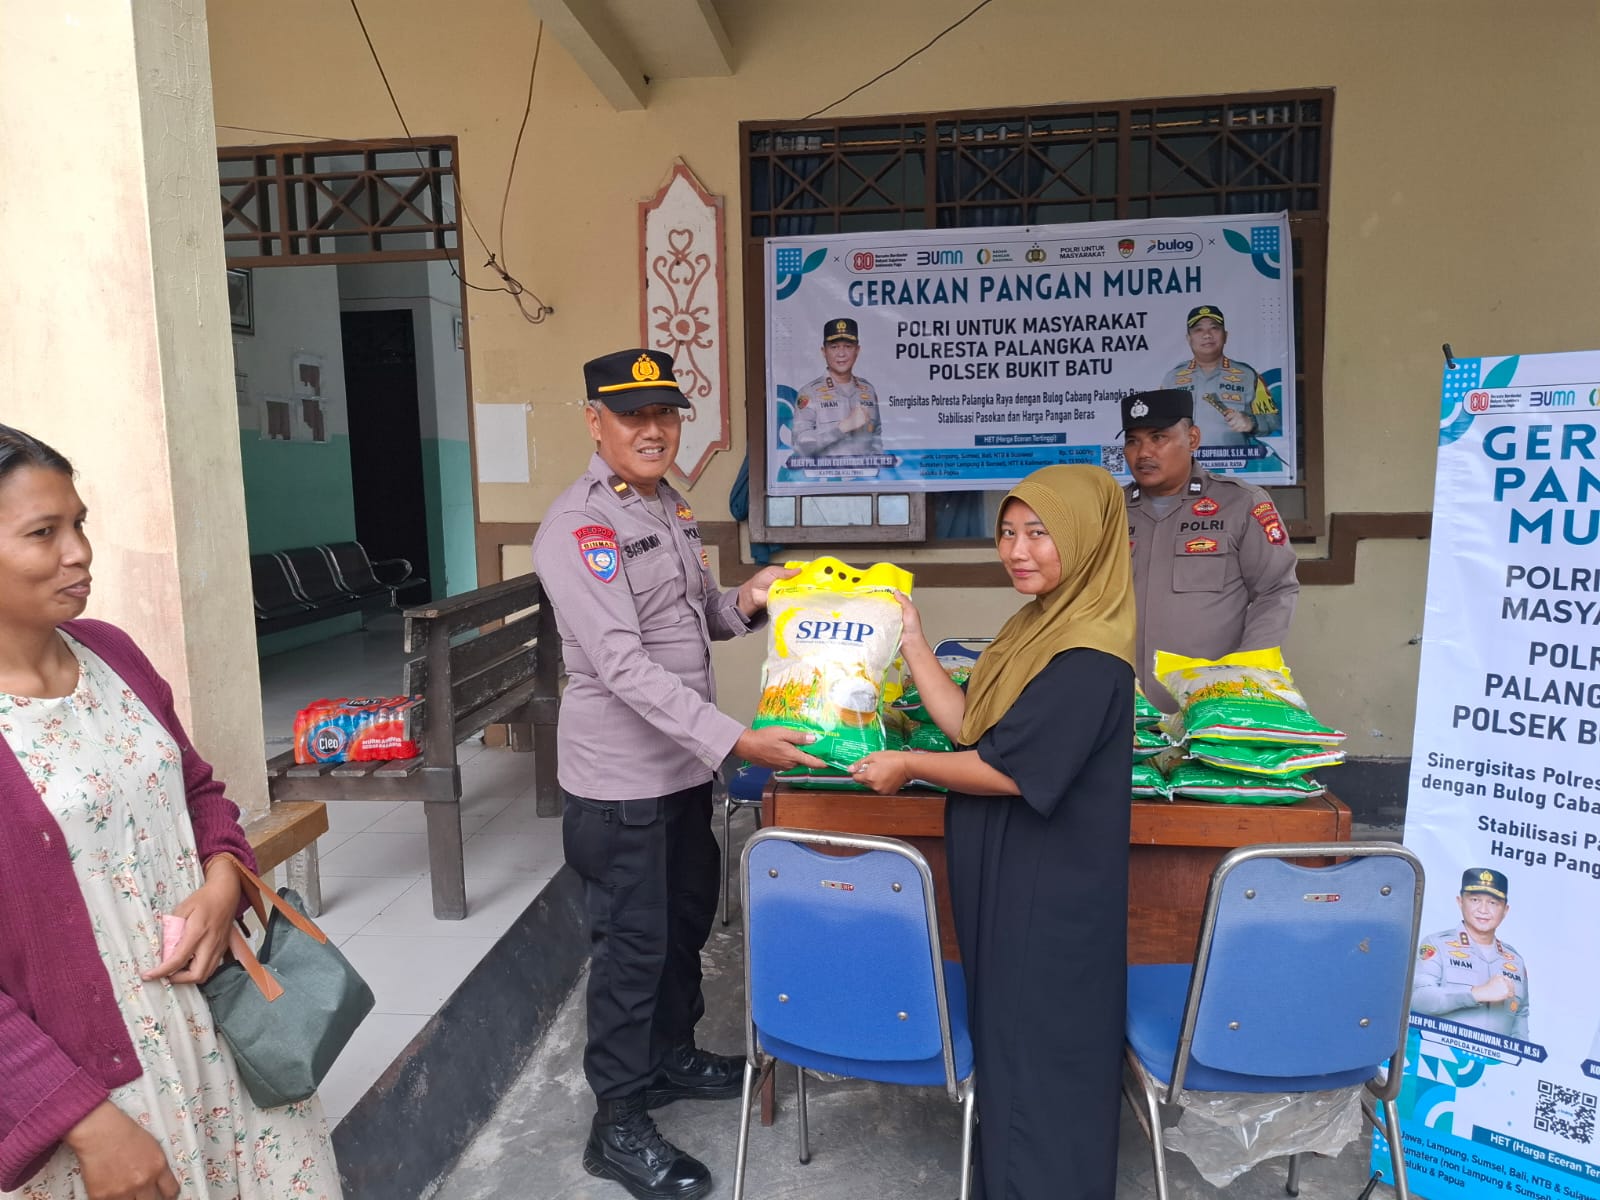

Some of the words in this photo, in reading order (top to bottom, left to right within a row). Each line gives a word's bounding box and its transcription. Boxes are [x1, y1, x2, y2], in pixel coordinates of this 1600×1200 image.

[1059, 251, 1105, 259] MASYARAKAT
[1158, 239, 1193, 252] bulog
[848, 277, 967, 306] GERAKAN
[980, 272, 1091, 303] PANGAN
[1104, 266, 1201, 297] MURAH
[898, 320, 950, 338] POLRI
[957, 318, 1016, 336] UNTUK
[1023, 312, 1148, 334] MASYARAKAT
[896, 340, 987, 360] POLRESTA
[995, 337, 1095, 357] PALANGKA
[1102, 335, 1149, 352] RAYA
[929, 362, 1000, 381] POLSEK
[1006, 360, 1060, 379] BUKIT
[1065, 358, 1113, 376] BATU
[888, 394, 930, 409] Sinergisitas
[931, 394, 960, 406] Polresta
[962, 394, 994, 408] Palangka
[996, 393, 1013, 407] Raya
[1015, 392, 1041, 406] dengan
[1043, 392, 1063, 406] Bulog
[1065, 391, 1092, 404] Cabang
[1094, 390, 1128, 404] Palangka
[1219, 383, 1244, 392] POLRI
[938, 412, 974, 424] Stabilisasi
[976, 411, 1005, 423] Pasokan
[1008, 411, 1020, 422] dan
[1022, 410, 1044, 424] Harga
[1045, 410, 1072, 424] Pangan
[1074, 408, 1096, 420] Beras
[1482, 424, 1600, 460] GER
[1494, 466, 1600, 502] PAN
[683, 528, 702, 540] POL
[1180, 520, 1224, 532] POLRI
[1508, 508, 1600, 546] MU
[584, 541, 614, 549] BINMAS
[1506, 565, 1600, 592] POLRI
[796, 620, 874, 642] SPHP
[1485, 672, 1600, 708] PALANG
[1452, 704, 1567, 742] POLSEK
[1578, 719, 1600, 745] B
[319, 738, 338, 750] Cleo
[1428, 752, 1536, 781] Sinergisitas
[1422, 774, 1486, 796] dengan
[1493, 782, 1546, 810] Bulog
[1554, 792, 1600, 815] Caba
[1478, 816, 1578, 847] Stabilisasi
[1491, 840, 1547, 866] Harga
[1554, 852, 1600, 880] Pang
[1450, 958, 1472, 970] IWAN
[1424, 1018, 1438, 1030] POL.
[1438, 1022, 1458, 1035] IWAN
[1441, 1037, 1470, 1050] KAPOLDA
[1472, 1044, 1502, 1058] KALTENG
[1401, 1130, 1424, 1147] Jawa,
[1426, 1138, 1469, 1162] Lampung,
[1472, 1154, 1506, 1176] Sumsel,
[1510, 1168, 1528, 1183] Bali,
[1532, 1176, 1552, 1190] NTB
[1554, 1184, 1561, 1193] &
[1490, 1132, 1511, 1148] HET
[1512, 1140, 1546, 1160] (Harga
[1548, 1152, 1582, 1172] Eceran
[1404, 1147, 1438, 1164] umatera
[1440, 1158, 1460, 1172] (non
[1462, 1165, 1504, 1190] Lampung
[1506, 1180, 1512, 1191] &
[1405, 1160, 1427, 1174] aluku
[1429, 1168, 1435, 1177] &
[1438, 1170, 1465, 1187] Papua
